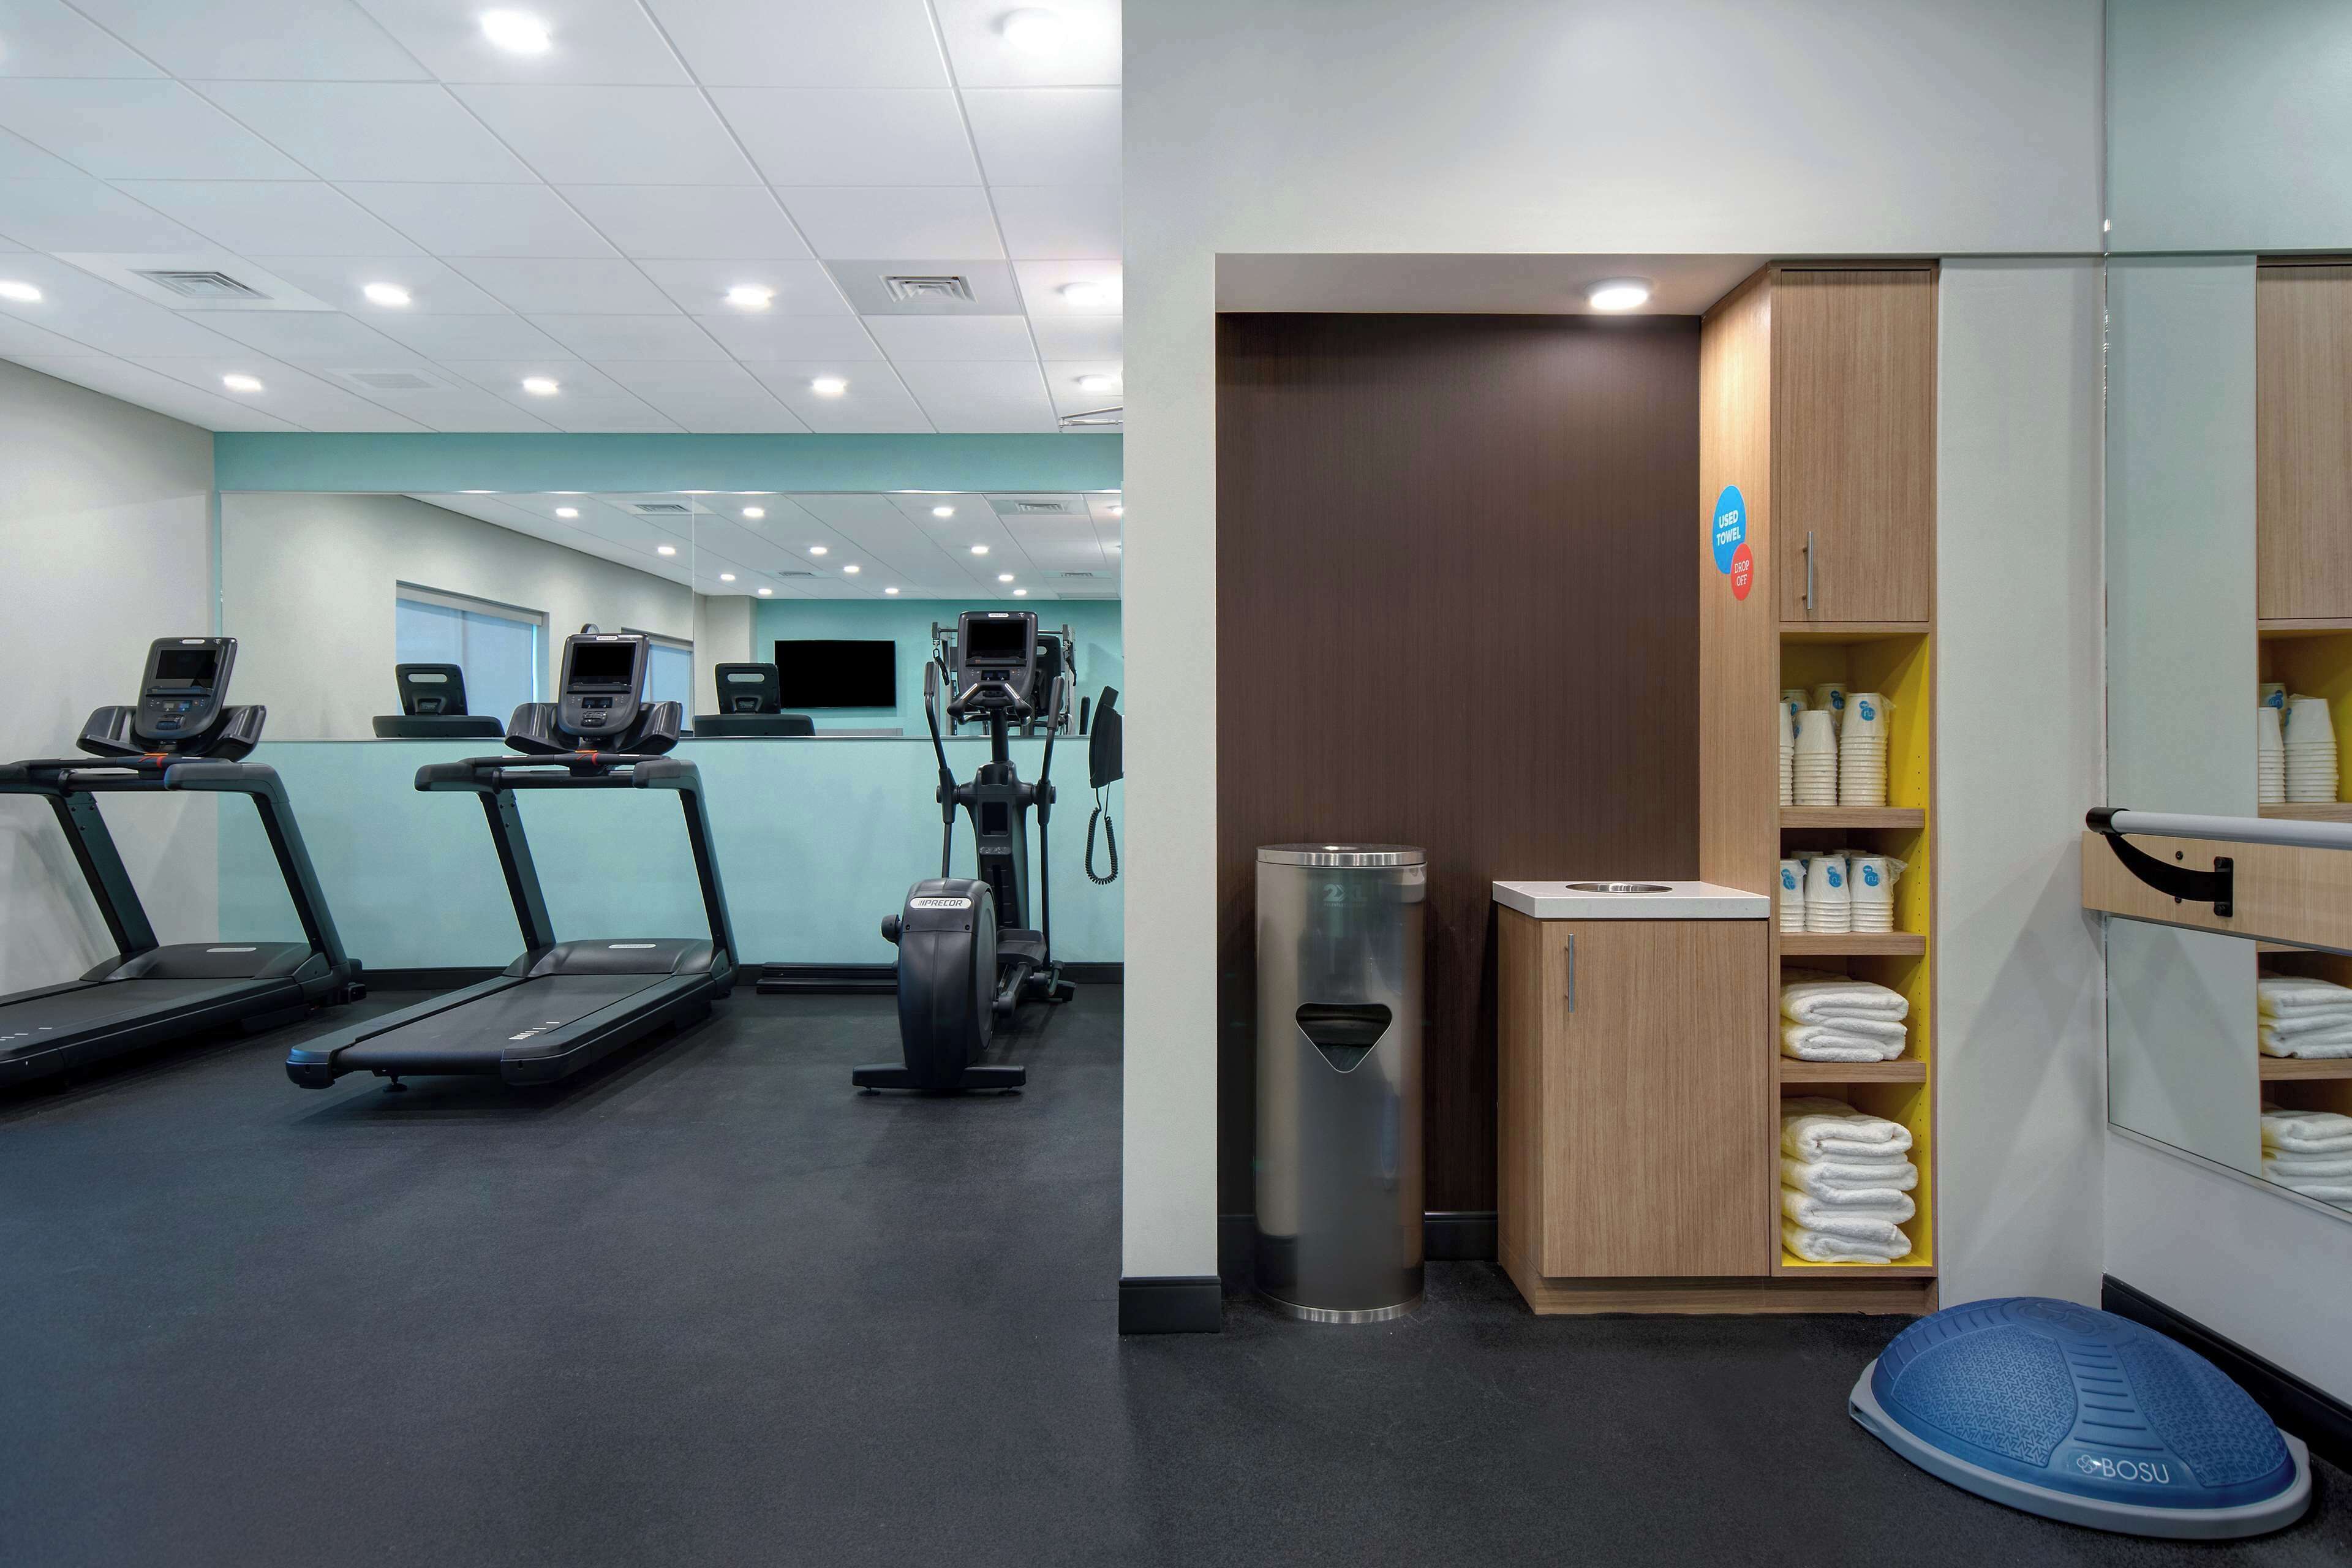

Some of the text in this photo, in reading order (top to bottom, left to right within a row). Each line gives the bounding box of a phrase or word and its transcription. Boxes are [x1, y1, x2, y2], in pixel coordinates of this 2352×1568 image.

[1719, 510, 1739, 529] USED
[1717, 527, 1741, 546] TOWEL
[1734, 560, 1749, 573] DROP
[1736, 575, 1747, 586] OFF
[2101, 1458, 2169, 1484] BOSU
